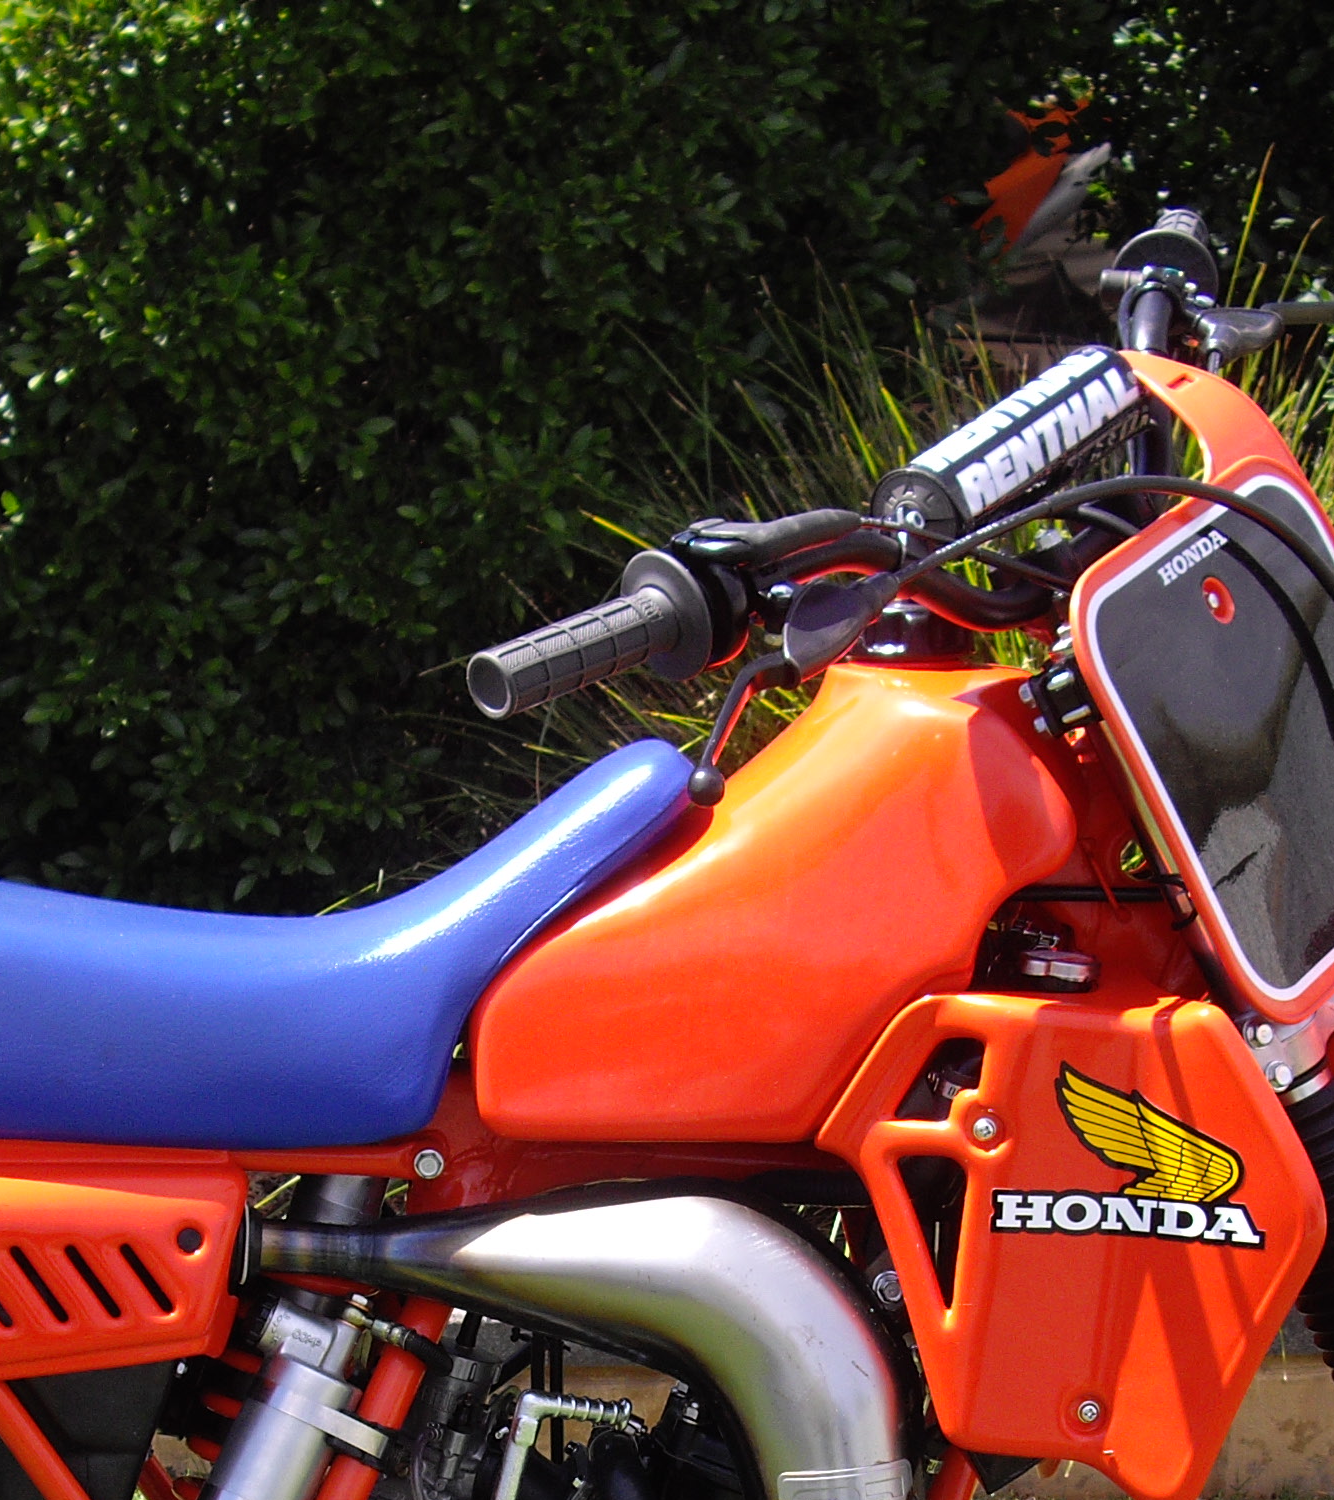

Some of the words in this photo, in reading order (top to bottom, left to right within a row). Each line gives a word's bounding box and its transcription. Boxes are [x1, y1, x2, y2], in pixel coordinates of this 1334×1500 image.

[955, 367, 1140, 517] RENTHAL
[1157, 529, 1228, 586] HONDA
[995, 1194, 1261, 1245] HONDA
